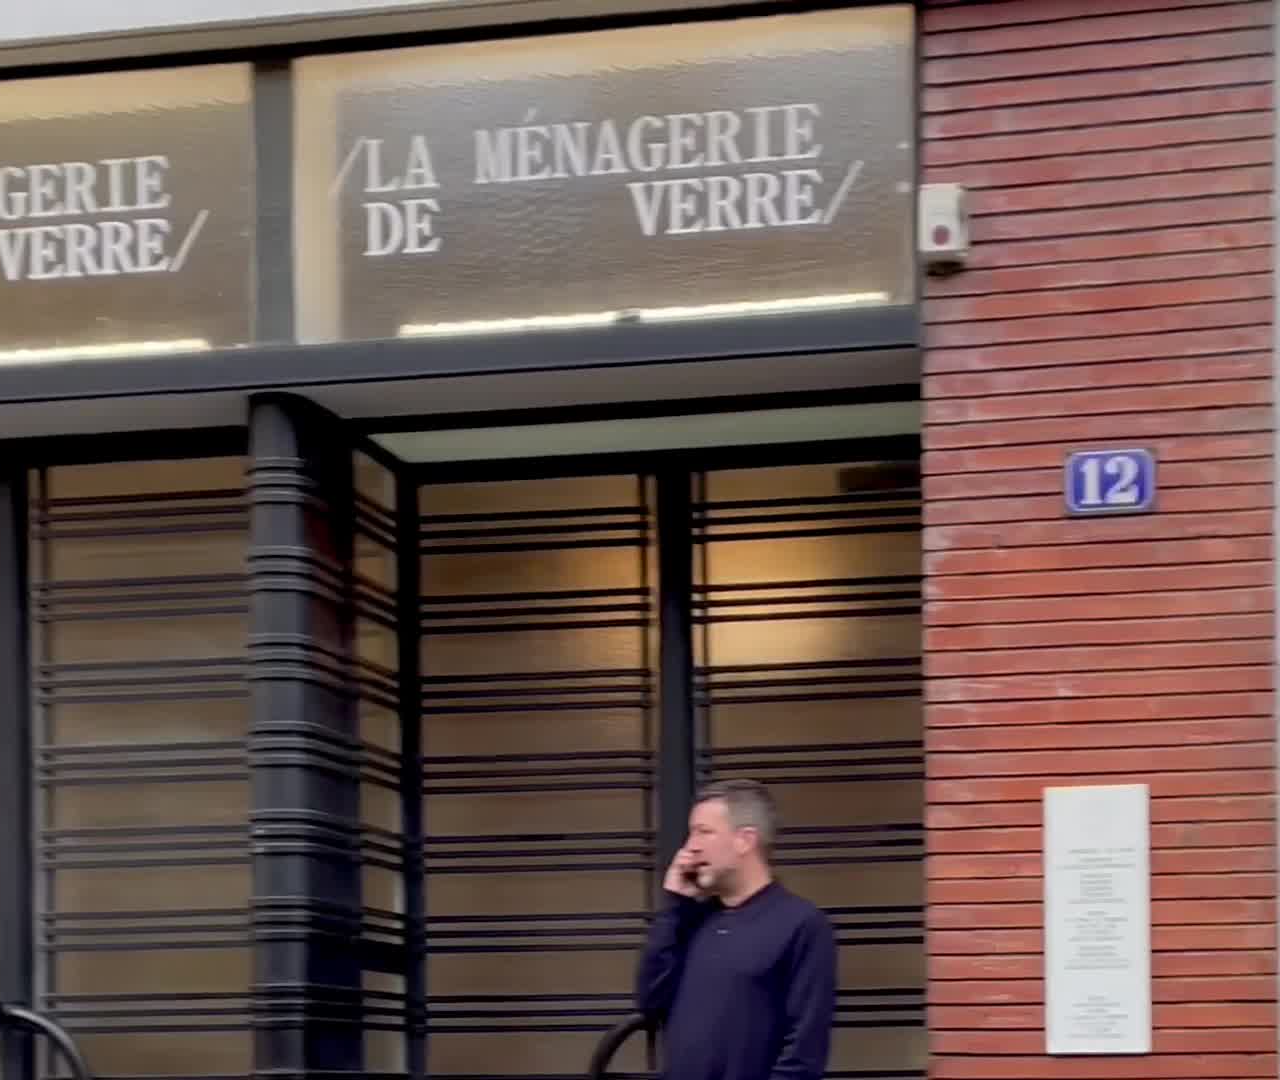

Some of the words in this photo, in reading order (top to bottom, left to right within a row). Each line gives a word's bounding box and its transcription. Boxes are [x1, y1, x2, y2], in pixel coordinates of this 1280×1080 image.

[472, 103, 824, 184] MÉNAGERIE
[361, 198, 441, 257] DE
[1079, 456, 1138, 504] 12
